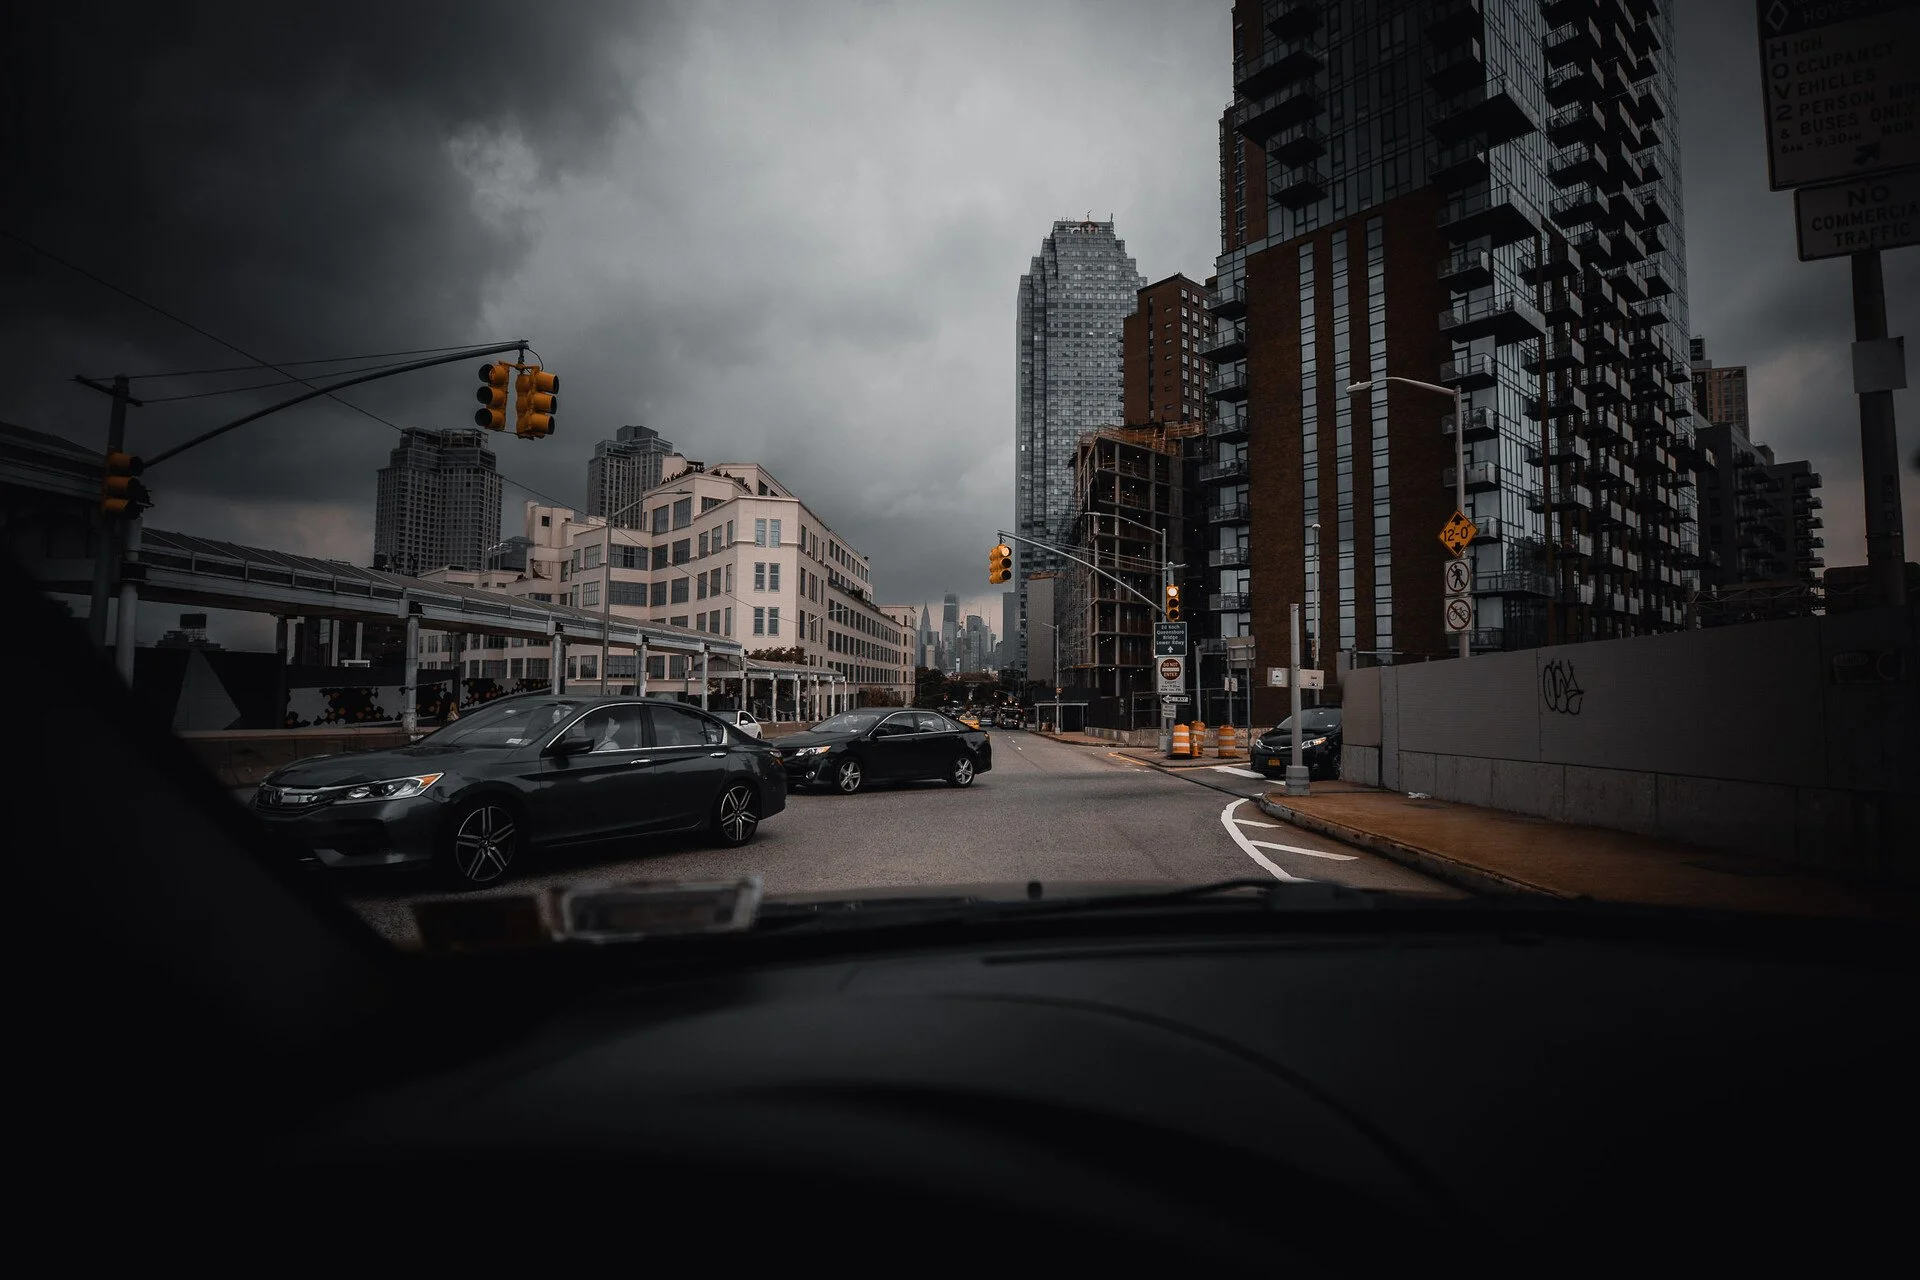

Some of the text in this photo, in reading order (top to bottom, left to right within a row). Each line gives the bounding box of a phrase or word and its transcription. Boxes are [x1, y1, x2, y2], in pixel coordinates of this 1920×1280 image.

[1772, 39, 1896, 80] OCCUPANCY
[1774, 68, 1876, 100] VEHICLES
[1775, 104, 1792, 122] 2
[1799, 89, 1876, 117] PERSON
[1780, 100, 1915, 140] & BUSES ONLY
[1848, 185, 1890, 208] NO
[1812, 200, 1919, 232] COMMERCIA
[1834, 222, 1911, 248] TRAFFIC
